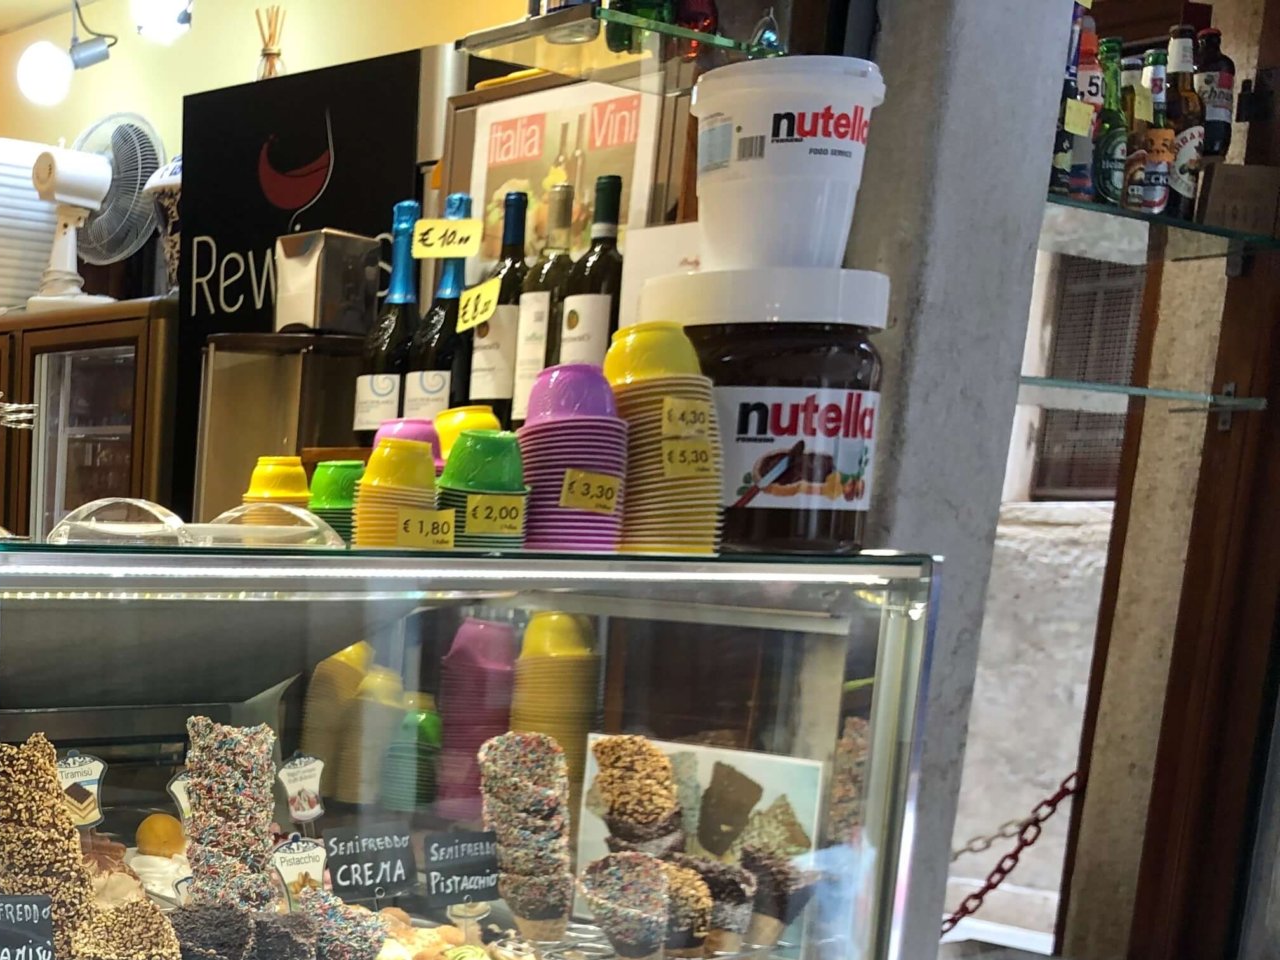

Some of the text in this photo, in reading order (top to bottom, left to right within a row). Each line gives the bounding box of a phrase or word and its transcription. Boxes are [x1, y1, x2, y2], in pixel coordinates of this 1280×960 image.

[591, 99, 639, 148] Vini
[489, 117, 541, 164] Italia
[678, 410, 706, 426] 4,30
[736, 391, 875, 440] nutella
[678, 450, 709, 467] 5,30
[581, 483, 615, 501] 3,30
[471, 505, 519, 522] € 2,00
[403, 519, 451, 537] € 1,80
[59, 768, 93, 781] Tiramisù
[328, 835, 410, 858] SEMIFREDDO
[280, 853, 320, 867] Pistacchio
[336, 858, 407, 887] CREMA
